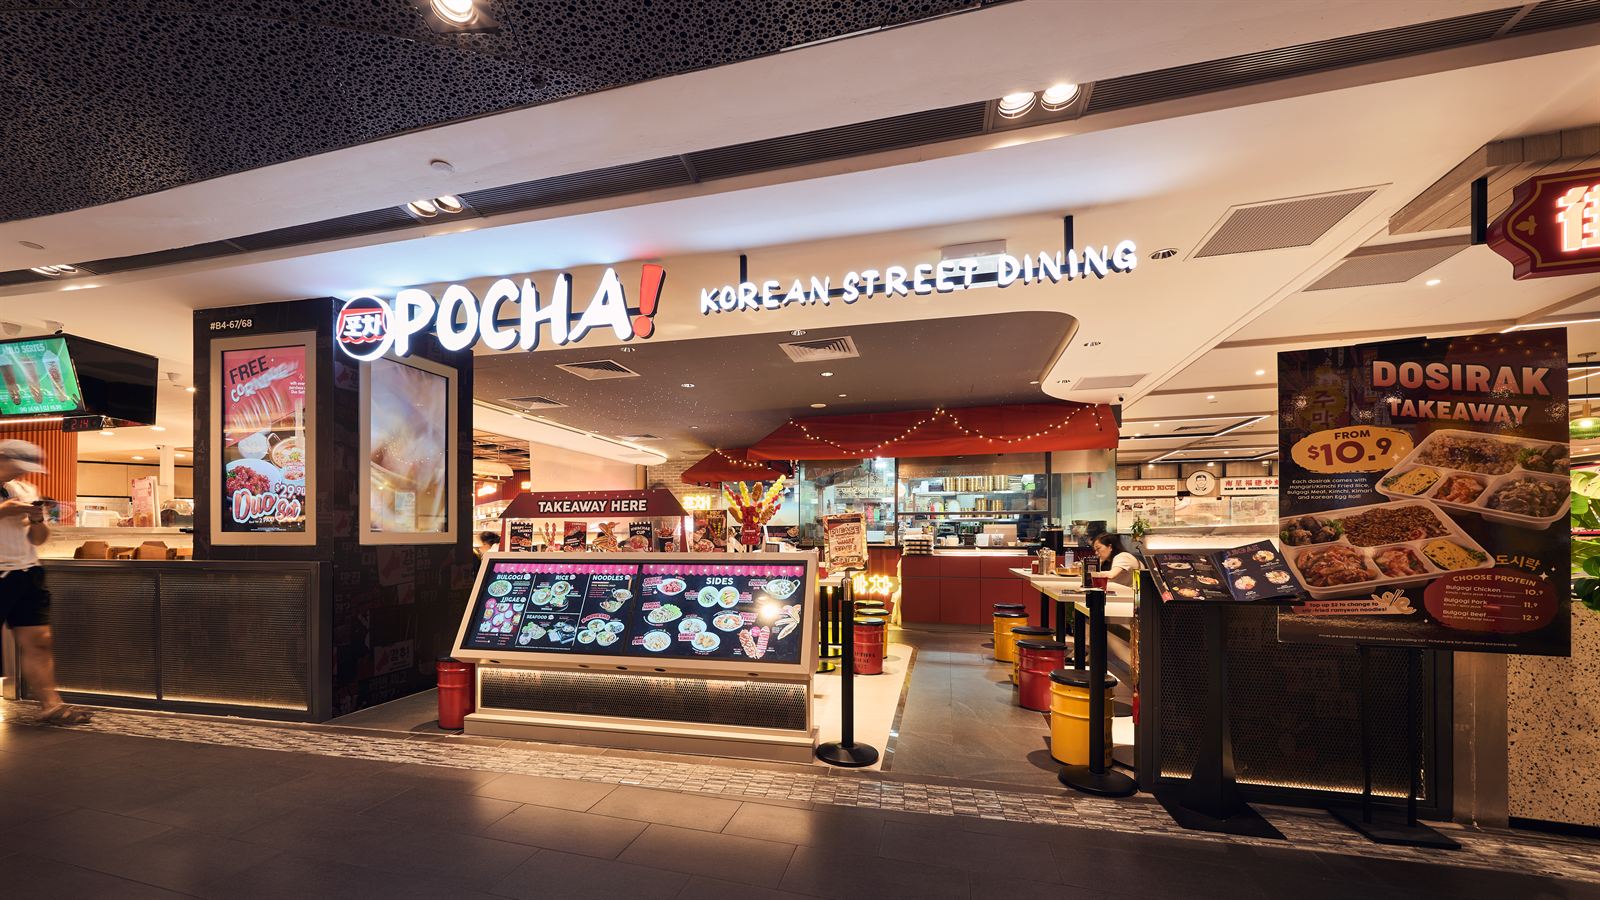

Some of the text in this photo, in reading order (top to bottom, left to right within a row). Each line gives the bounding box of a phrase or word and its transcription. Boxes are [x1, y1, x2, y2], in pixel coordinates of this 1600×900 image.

[699, 239, 1139, 315] KOREAN STREET DINING
[393, 263, 666, 357] POCHA!
[209, 318, 253, 331] #B4-67/68
[343, 313, 383, 337] 포차
[229, 355, 269, 385] FREE
[1371, 360, 1550, 396] DOSIRAK
[1389, 398, 1528, 425] TAKEAWAY
[1334, 429, 1371, 441] FROM
[1307, 437, 1392, 466] $10.9
[232, 488, 301, 524] Duo Set
[538, 499, 648, 514] TAKEAWAY HERE
[830, 527, 860, 538] PLEASE
[1494, 554, 1542, 572] 도시락
[705, 577, 734, 586] SIDES
[1445, 584, 1472, 592] Bulgogi
[1452, 574, 1537, 587] CHOOSE PROTEIN
[1443, 597, 1470, 605] Bulgogi
[1442, 609, 1469, 617] Bulgogi
